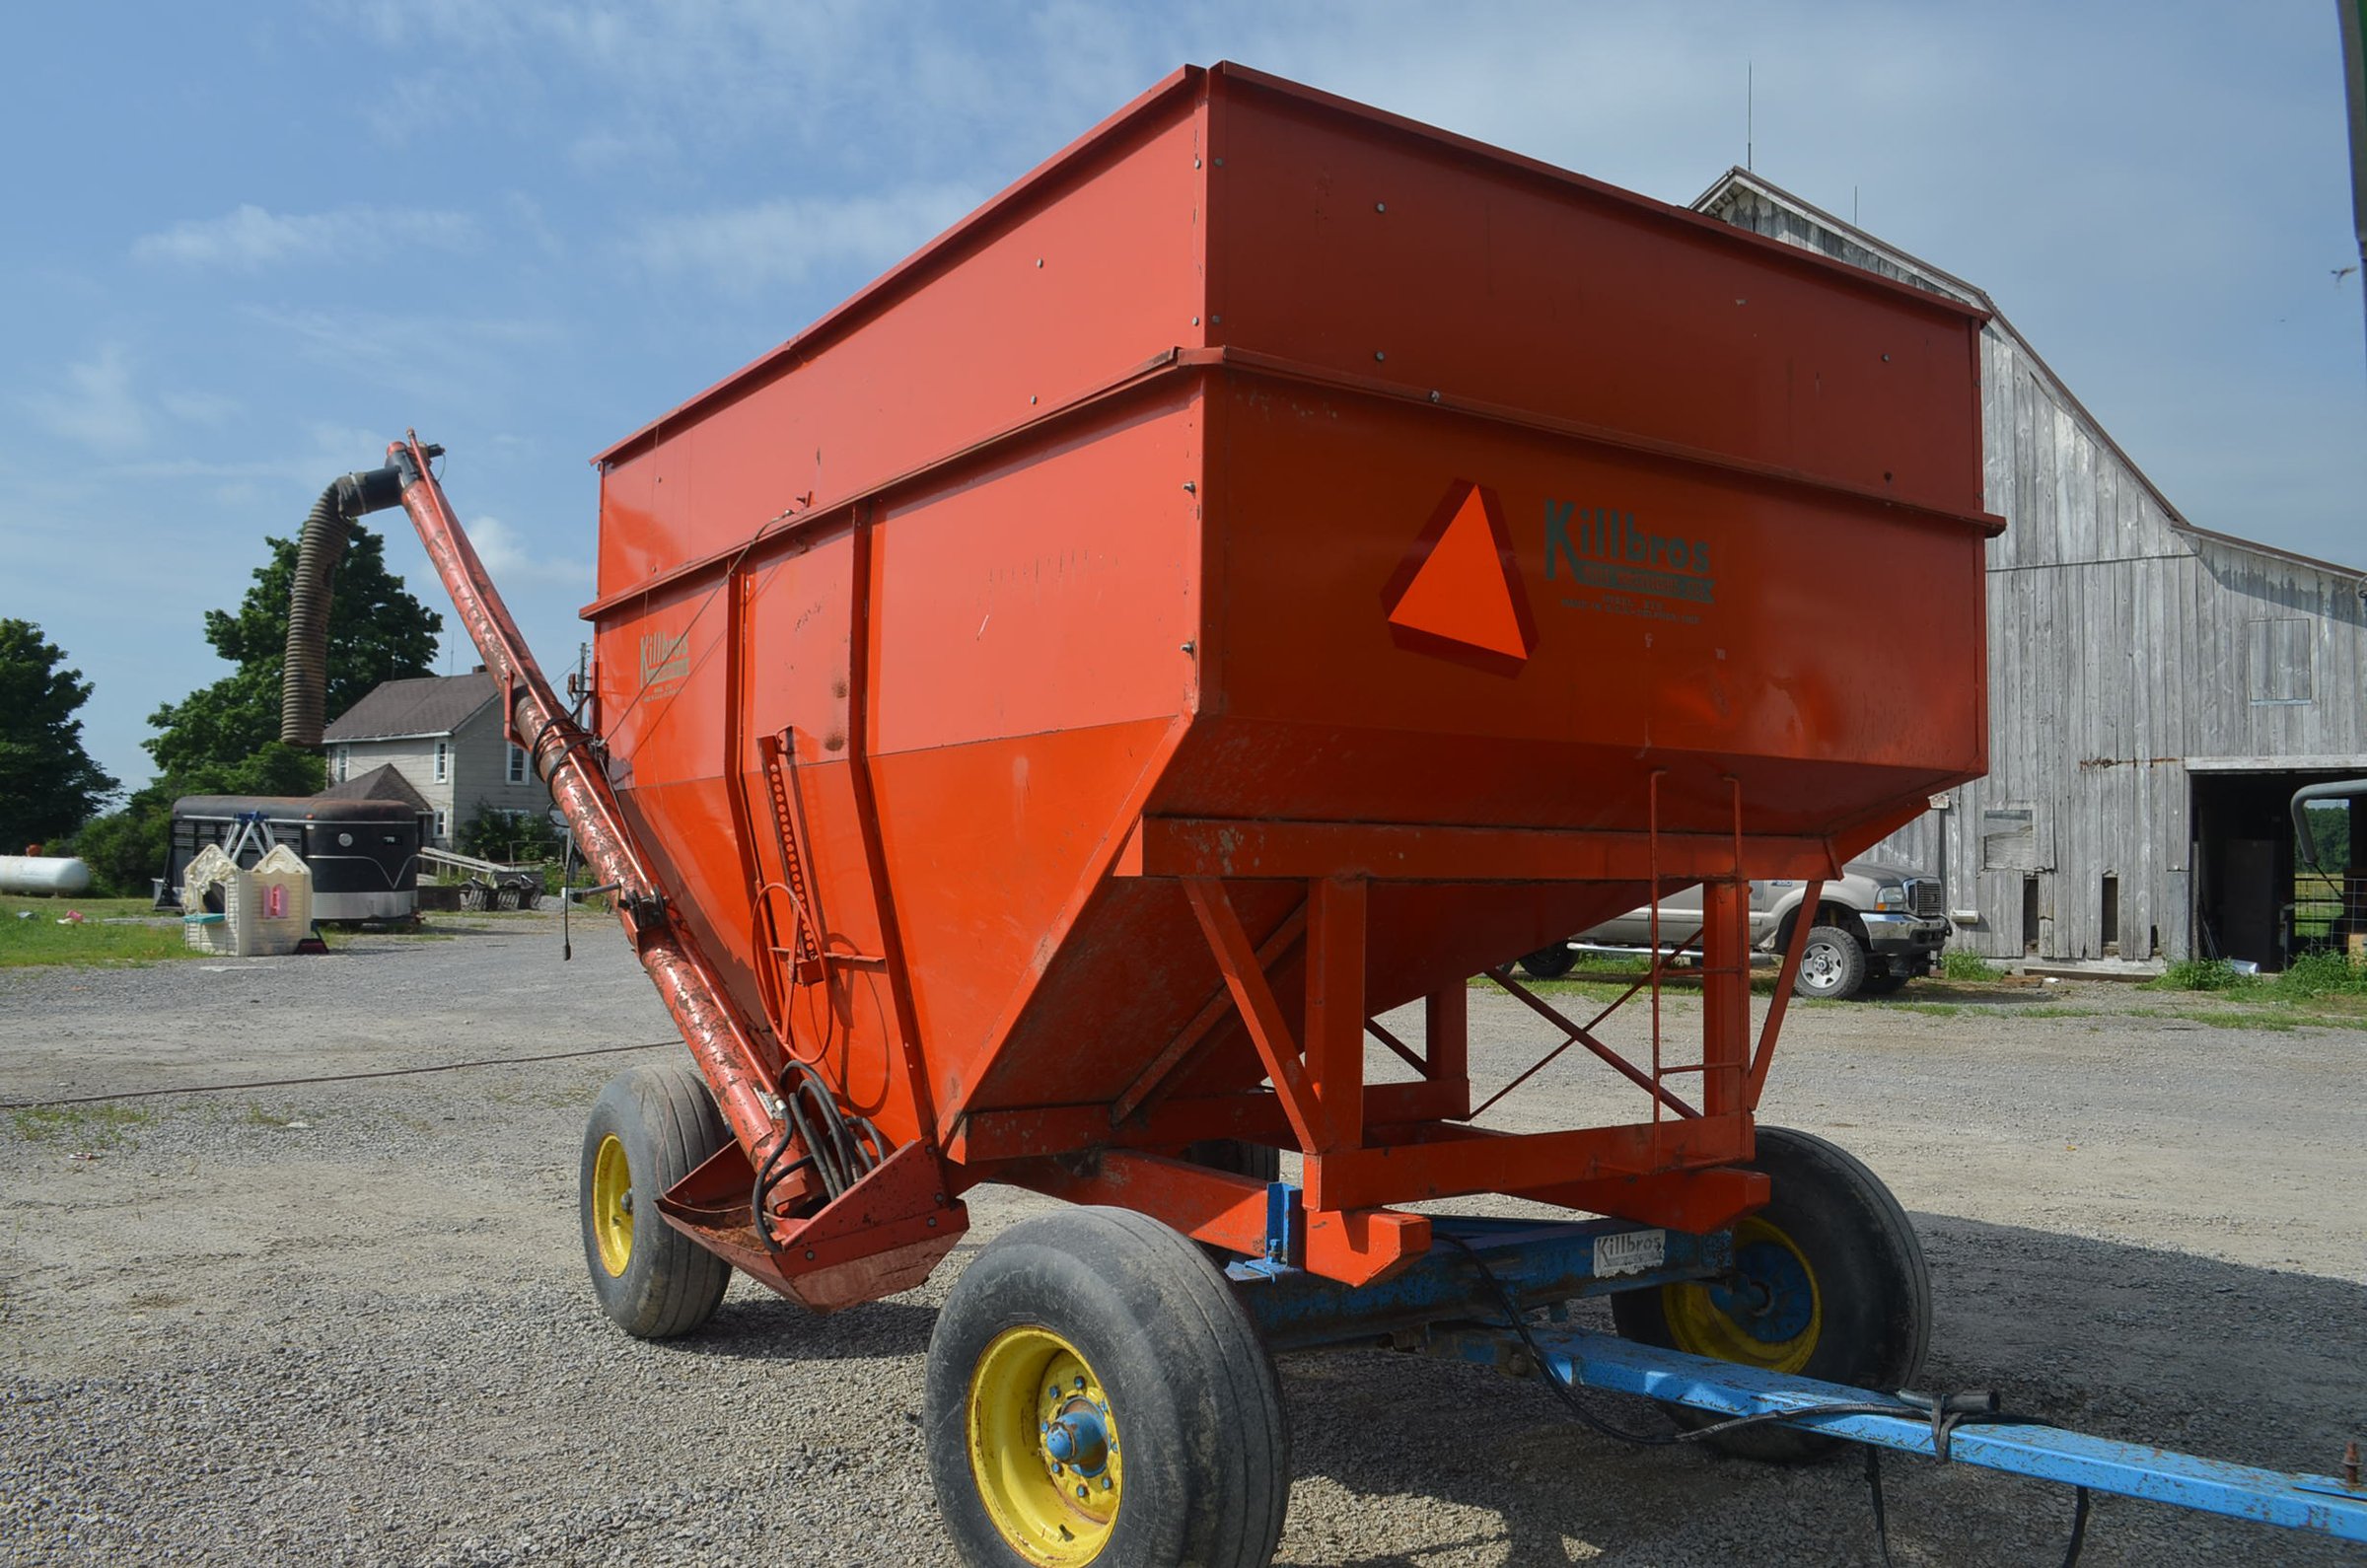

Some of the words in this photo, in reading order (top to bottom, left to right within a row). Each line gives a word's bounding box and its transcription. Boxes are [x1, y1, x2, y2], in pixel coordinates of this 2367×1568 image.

[1545, 498, 1710, 582] Killbros
[639, 630, 688, 689] Killbros
[1597, 1235, 1662, 1266] Killbros
